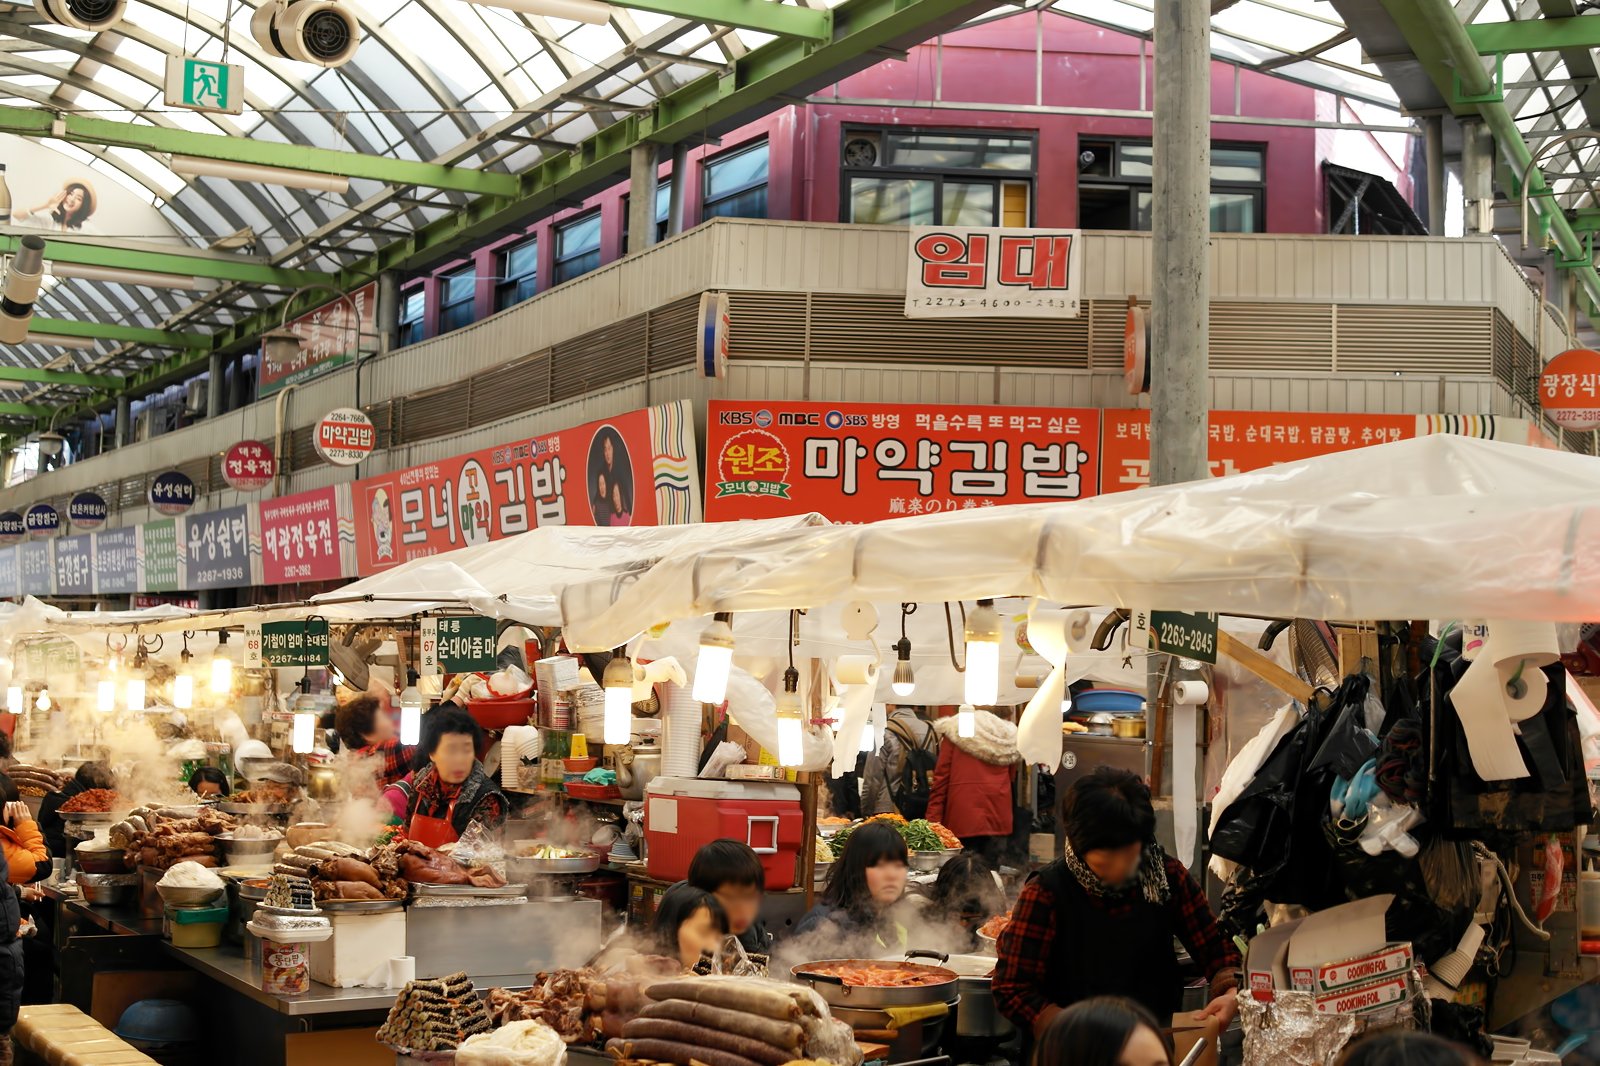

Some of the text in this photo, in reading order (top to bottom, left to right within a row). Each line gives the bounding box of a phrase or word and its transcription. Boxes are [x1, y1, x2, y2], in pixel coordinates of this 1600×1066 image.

[914, 232, 1073, 290] 임대
[1543, 373, 1600, 398] 광장식
[719, 411, 1081, 434] KBS MBC SBS 방영 먹을수록 또 먹고 싶은
[322, 425, 373, 447] 마약김밥
[547, 436, 560, 453] 방영
[1361, 427, 1402, 444] 추어탕
[238, 446, 261, 458] 대광
[724, 444, 785, 475] 원조
[228, 459, 272, 475] 정육점
[803, 436, 1089, 498] 마약김밥
[153, 482, 193, 499] 유성쉼터
[725, 482, 746, 493] 모녀
[759, 482, 781, 494] 김밥
[400, 479, 456, 545] 모녀
[461, 500, 490, 540] 마약
[494, 455, 567, 535] 김밥
[188, 514, 248, 562] 유성쉼터
[265, 517, 333, 562] 대광정육점
[58, 554, 89, 587] 금강침구
[248, 640, 259, 650] 68
[263, 633, 286, 649] 기철이
[287, 633, 303, 649] 엄마
[424, 640, 434, 652] 67
[438, 636, 495, 660] 순대아줌마
[1161, 621, 1213, 655] 2263-2845
[425, 655, 433, 666] 호
[1347, 959, 1387, 980] COOKING FOIL
[1336, 991, 1380, 1013] COOKING FOIL
